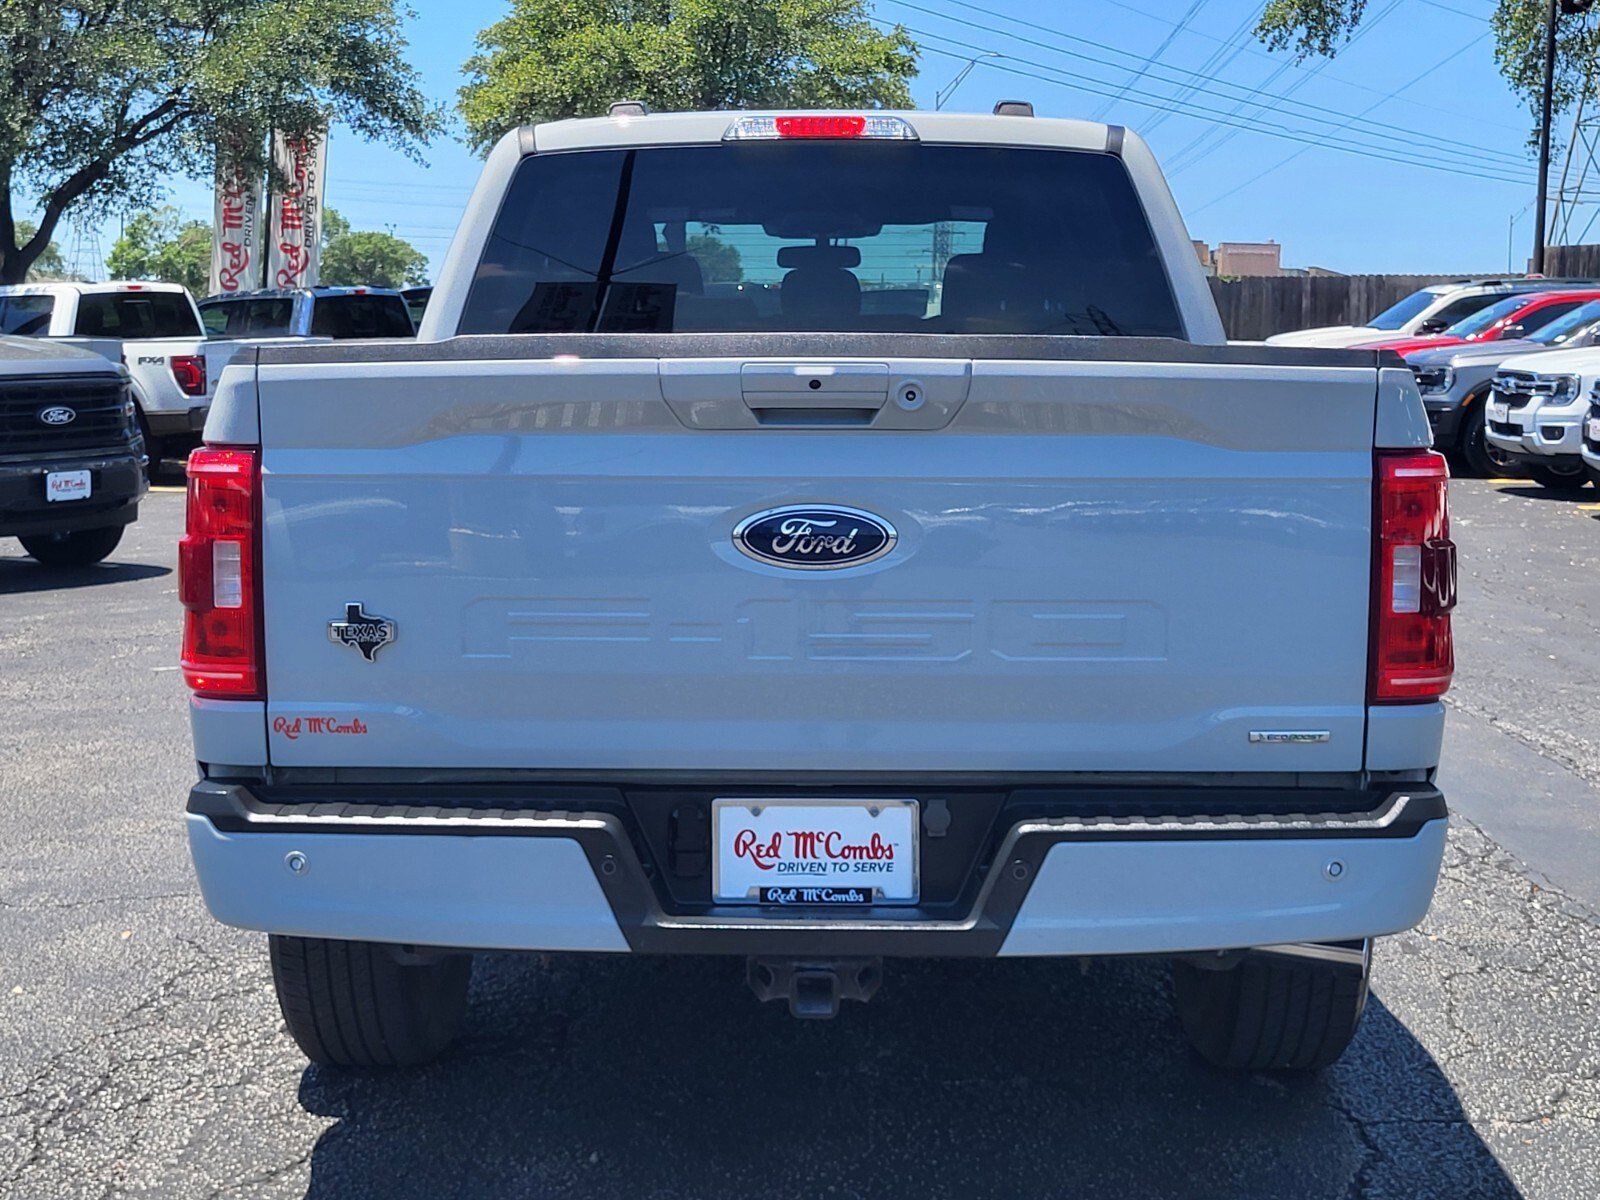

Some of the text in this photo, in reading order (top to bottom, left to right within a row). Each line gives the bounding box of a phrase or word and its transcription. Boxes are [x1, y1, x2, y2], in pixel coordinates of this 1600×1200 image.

[304, 196, 317, 249] DRIVEN
[219, 241, 249, 291] Red
[276, 241, 310, 288] Red
[138, 356, 164, 365] FX4
[48, 410, 70, 422] Ford
[772, 518, 858, 554] Ford
[333, 624, 388, 638] TEXAS
[273, 716, 368, 739] Red McCombs
[734, 829, 894, 870] Red McCombs
[777, 862, 894, 873] DRIVEN TO SERVE
[767, 887, 865, 903] Red McCombs
